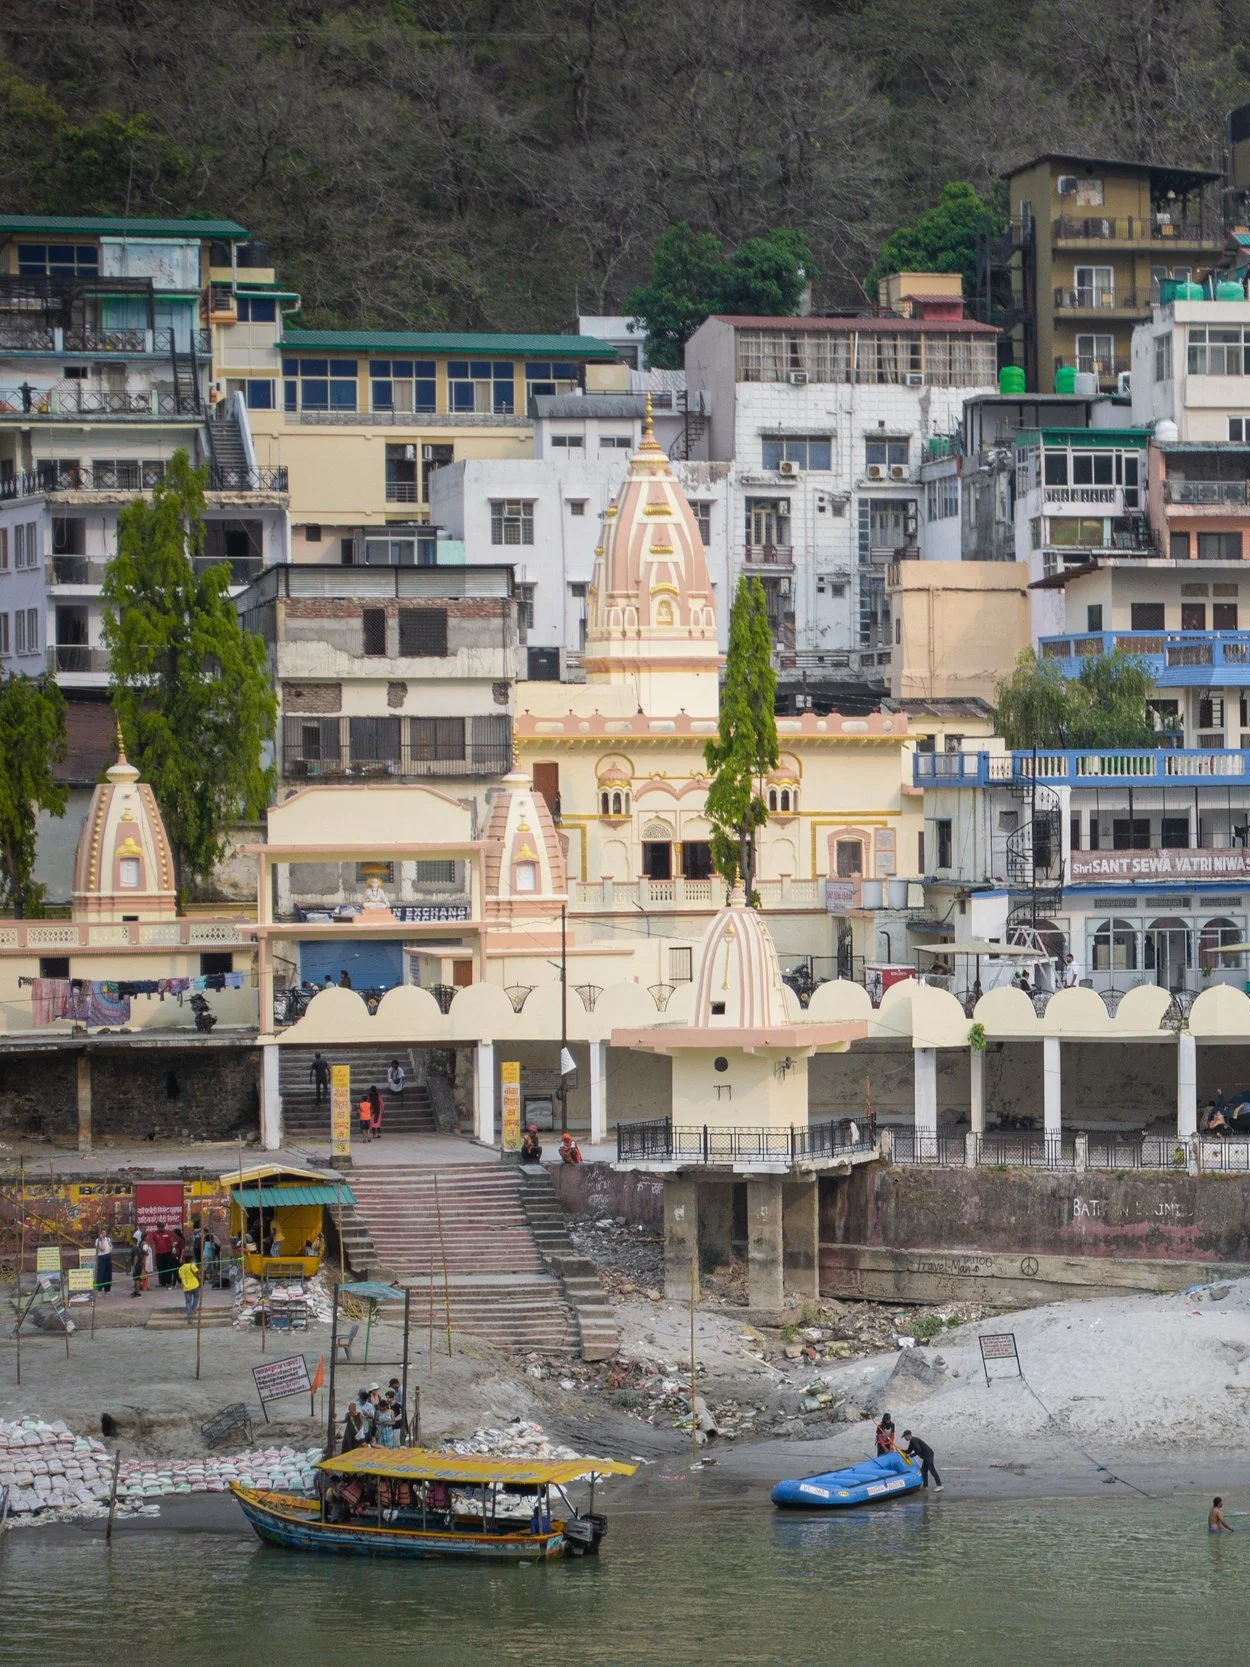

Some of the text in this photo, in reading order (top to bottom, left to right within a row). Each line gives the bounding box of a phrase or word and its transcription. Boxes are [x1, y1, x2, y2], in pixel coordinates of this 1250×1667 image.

[1073, 862, 1092, 874] Shri
[1093, 859, 1131, 874] SANT
[1132, 858, 1172, 873] SEWA
